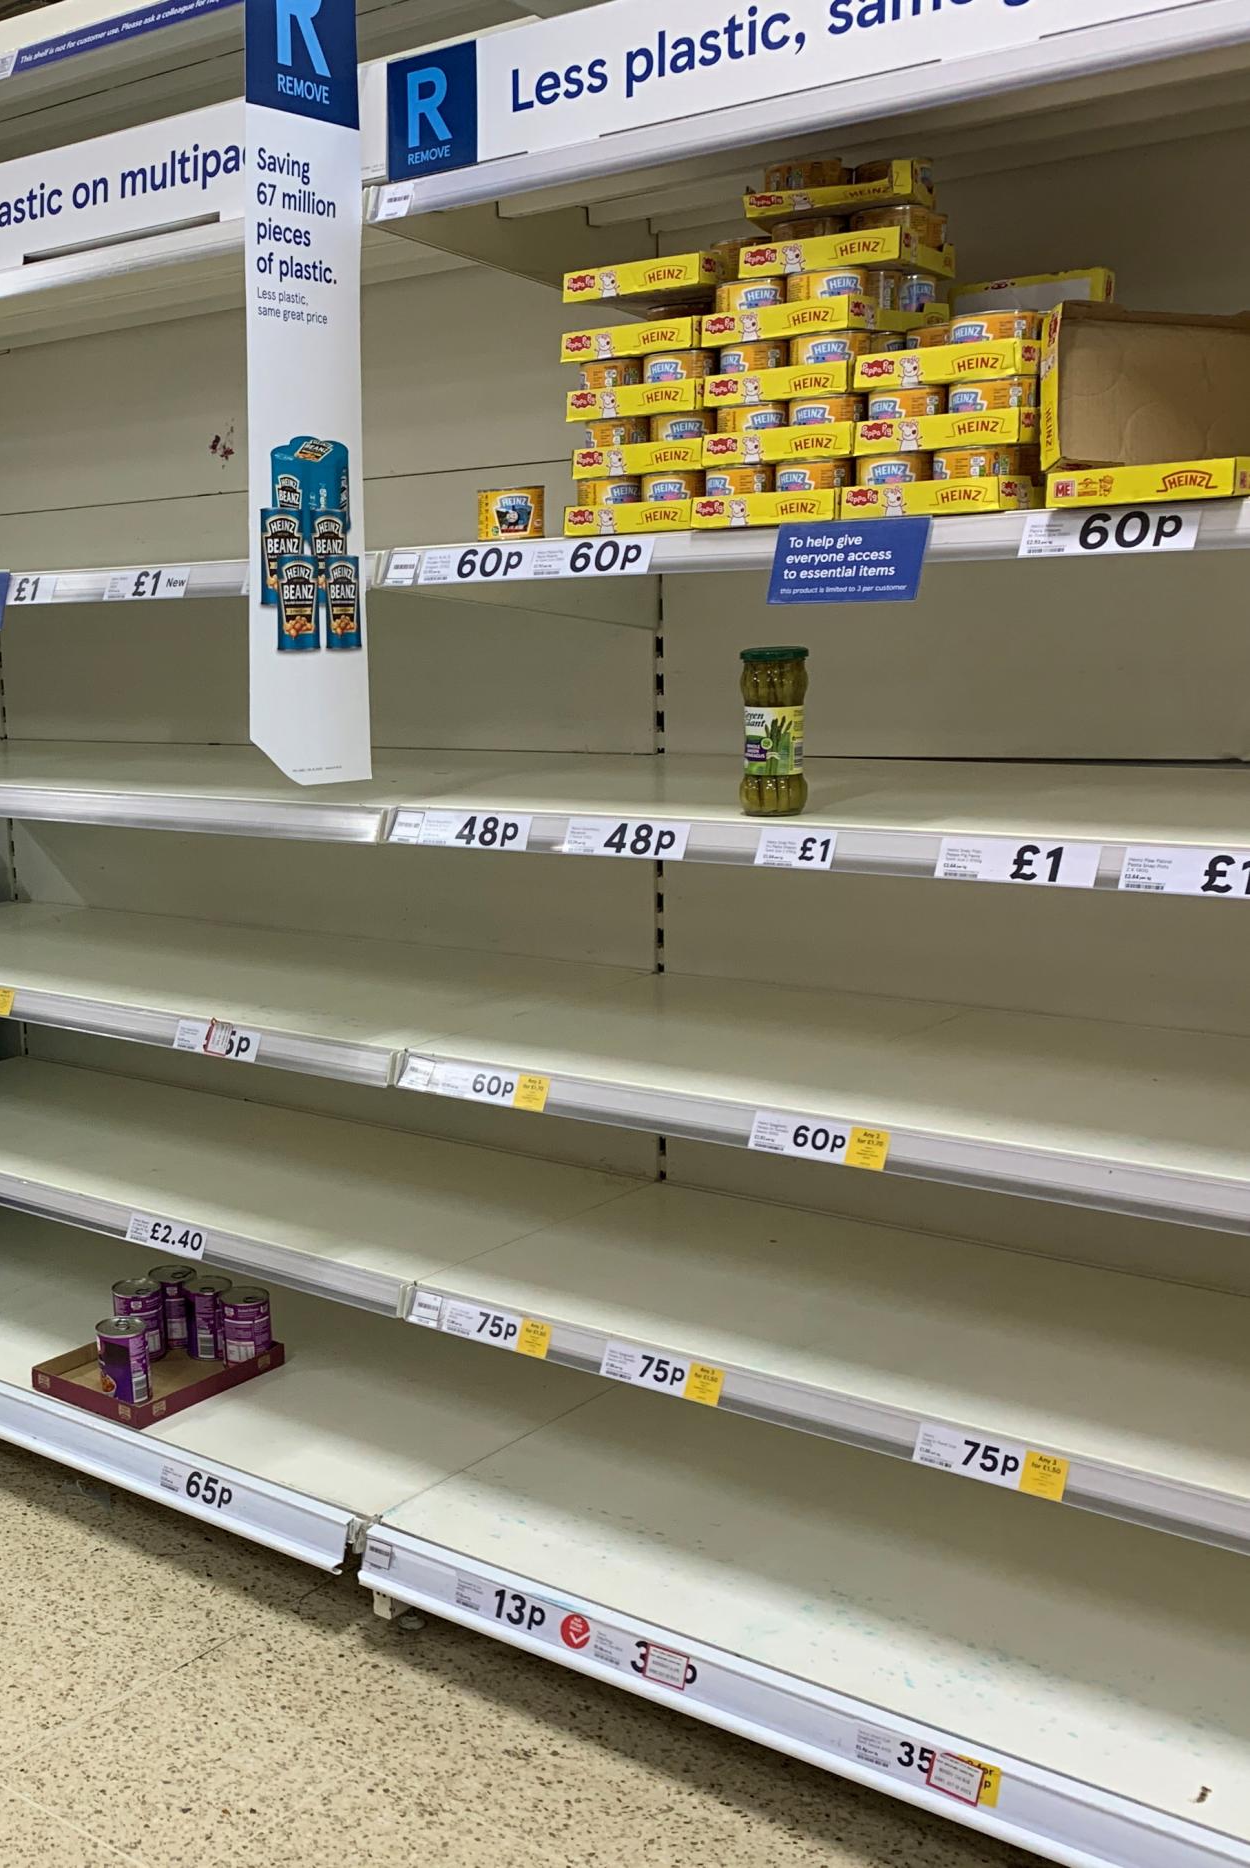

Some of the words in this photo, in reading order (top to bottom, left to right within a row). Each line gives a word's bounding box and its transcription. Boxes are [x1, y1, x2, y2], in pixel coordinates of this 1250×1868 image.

[20, 54, 32, 64] This
[34, 48, 50, 60] shelf
[66, 39, 77, 50] for
[77, 31, 107, 46] customer
[107, 27, 121, 37] use.
[121, 19, 143, 32] Please
[143, 15, 155, 25] ask
[162, 4, 195, 19] colleague
[276, 0, 331, 77] R
[510, 52, 608, 113] Less
[624, 4, 806, 99] plastic,
[278, 74, 330, 104] REMOVE
[407, 66, 452, 148] R
[257, 148, 310, 185] Saving
[408, 145, 450, 165] REMOVE
[71, 176, 109, 209] on
[120, 141, 245, 199] multipa
[257, 182, 276, 206] 67
[282, 186, 336, 219] million
[257, 218, 311, 247] pieces
[745, 251, 765, 265] Peppa
[765, 249, 777, 261] Pig
[839, 241, 880, 257] HEINZ
[257, 253, 273, 275] of
[279, 255, 337, 284] plastic.
[257, 287, 276, 301] Less
[278, 290, 308, 306] plastic,
[257, 305, 280, 318] same
[283, 308, 304, 322] great
[306, 312, 328, 325] price
[861, 362, 882, 377] Peppa
[882, 360, 894, 373] Pig
[957, 357, 999, 373] HEINZ
[1170, 475, 1207, 489] HEINZ
[270, 520, 295, 533] HEINZ
[1078, 511, 1183, 550] 60p
[267, 538, 299, 554] BEANZ
[788, 537, 803, 548] To
[806, 535, 834, 549] help
[837, 534, 863, 549] give
[457, 547, 523, 579] 60p
[569, 540, 642, 573] 60p
[786, 552, 844, 565] everyone
[847, 549, 892, 561] access
[132, 570, 161, 597] £1
[166, 578, 187, 589] New
[286, 567, 310, 580] HEINZ
[784, 568, 797, 580] to
[800, 565, 855, 579] essential
[859, 564, 896, 577] items
[14, 577, 40, 602] £1
[283, 584, 313, 600] BEANZ
[793, 587, 818, 595] product
[862, 585, 873, 593] per
[875, 584, 907, 592] customer
[454, 815, 520, 847] 48p
[603, 823, 676, 856] 48p
[798, 837, 831, 863] £1
[1010, 844, 1065, 883] £1
[225, 1031, 250, 1057] 5p
[471, 1072, 514, 1098] 60p
[793, 1124, 846, 1153] 60p
[150, 1221, 203, 1251] £2.40
[476, 1311, 517, 1340] 75p
[638, 1354, 685, 1385] 75p
[961, 1440, 1020, 1477] 75p
[185, 1470, 233, 1509] 65p
[494, 1588, 546, 1630] 13p
[896, 1741, 936, 1774] 35
